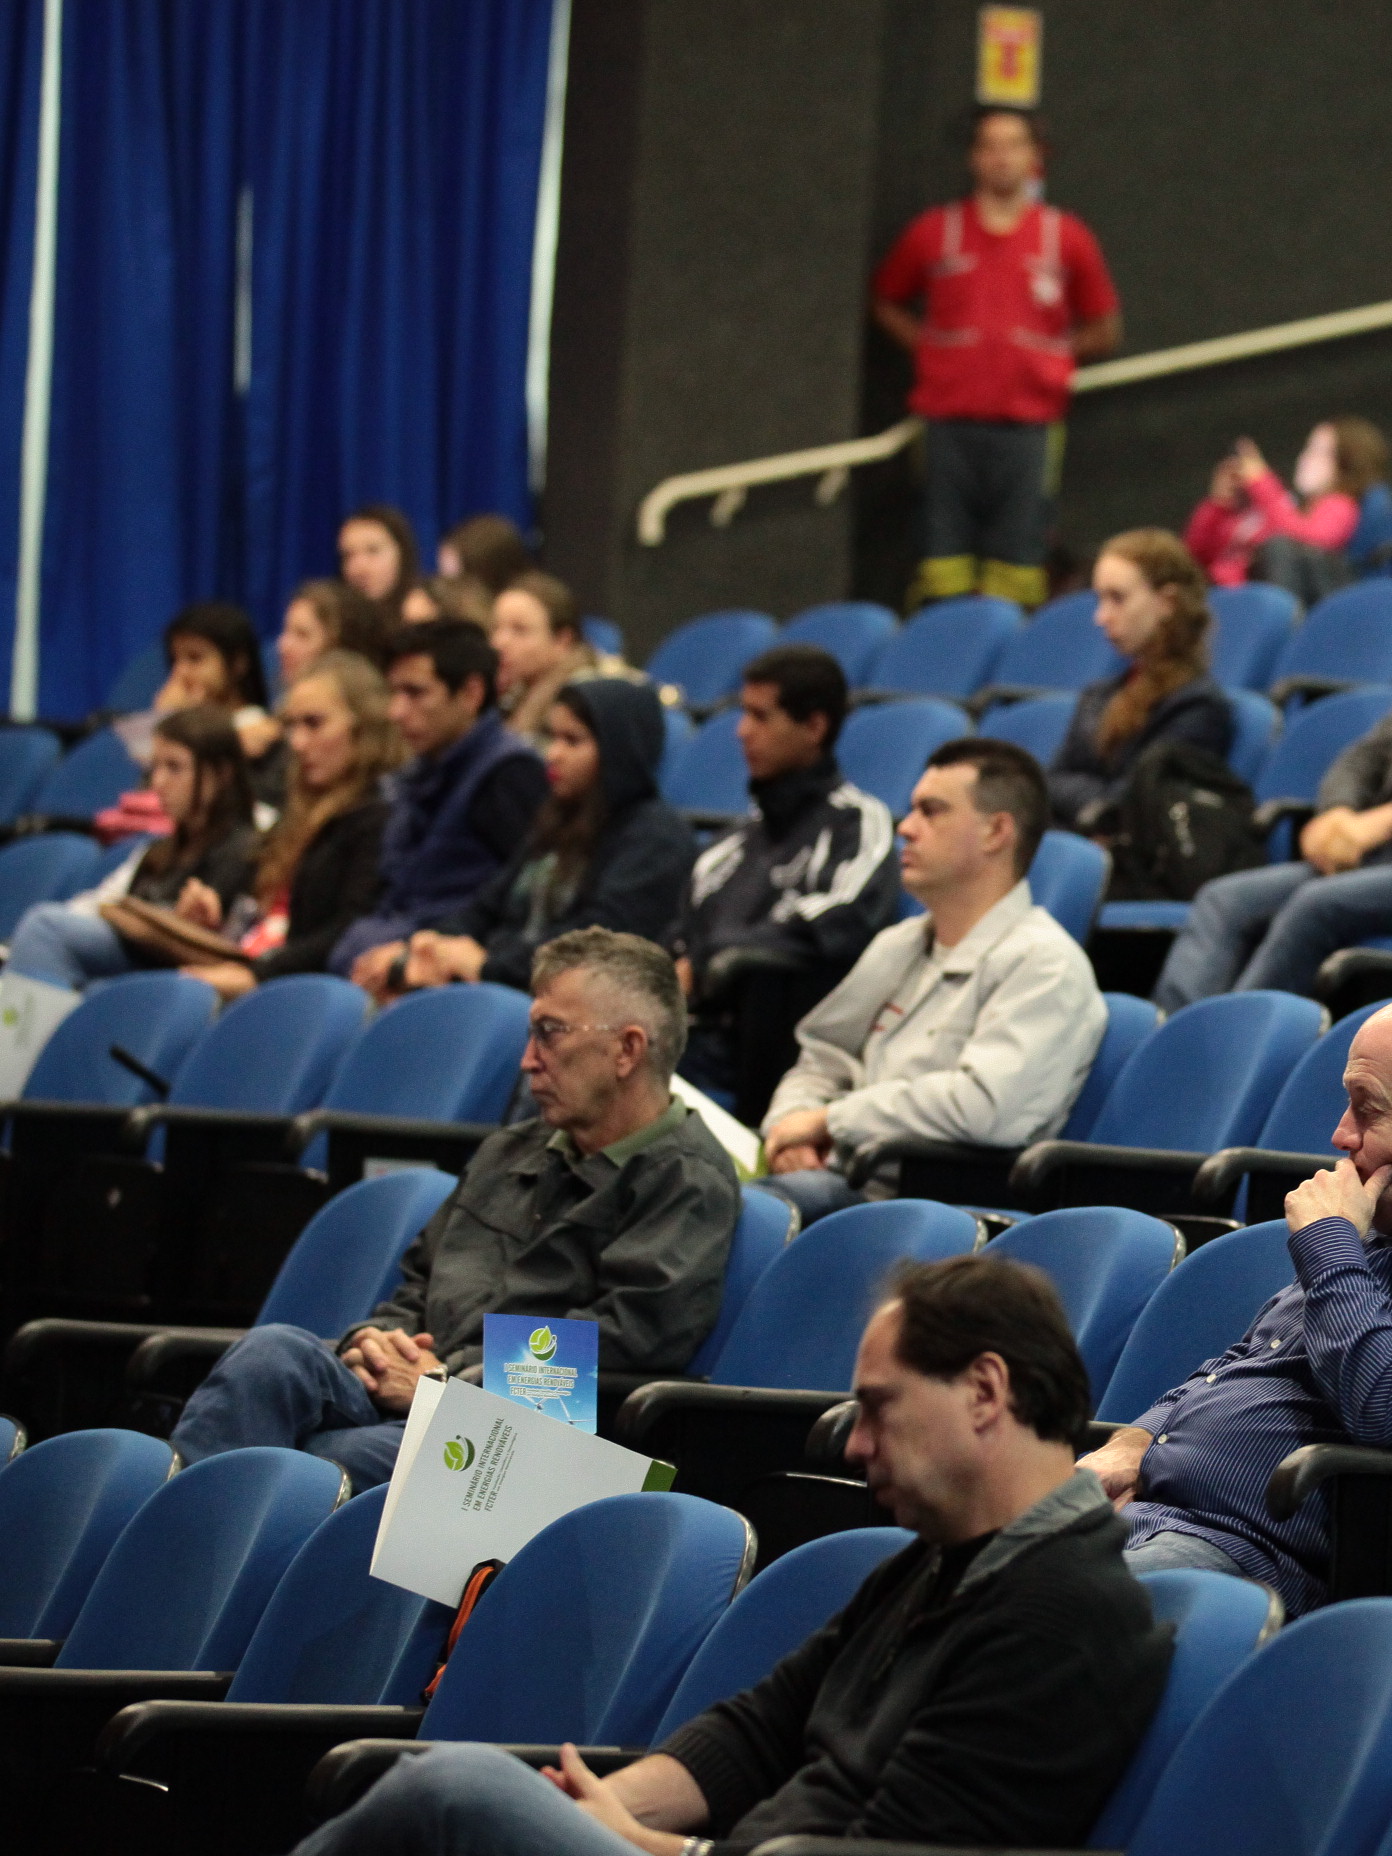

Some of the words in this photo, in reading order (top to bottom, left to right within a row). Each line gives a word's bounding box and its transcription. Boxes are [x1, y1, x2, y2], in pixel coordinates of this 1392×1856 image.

[538, 1366, 577, 1377] INTERNACIONAL
[517, 1376, 543, 1386] ENERGIAS
[478, 1417, 505, 1469] INTERNACIONAL
[477, 1467, 496, 1500] ENERGIAS
[473, 1500, 482, 1511] EM
[484, 1491, 498, 1512] FCTER
